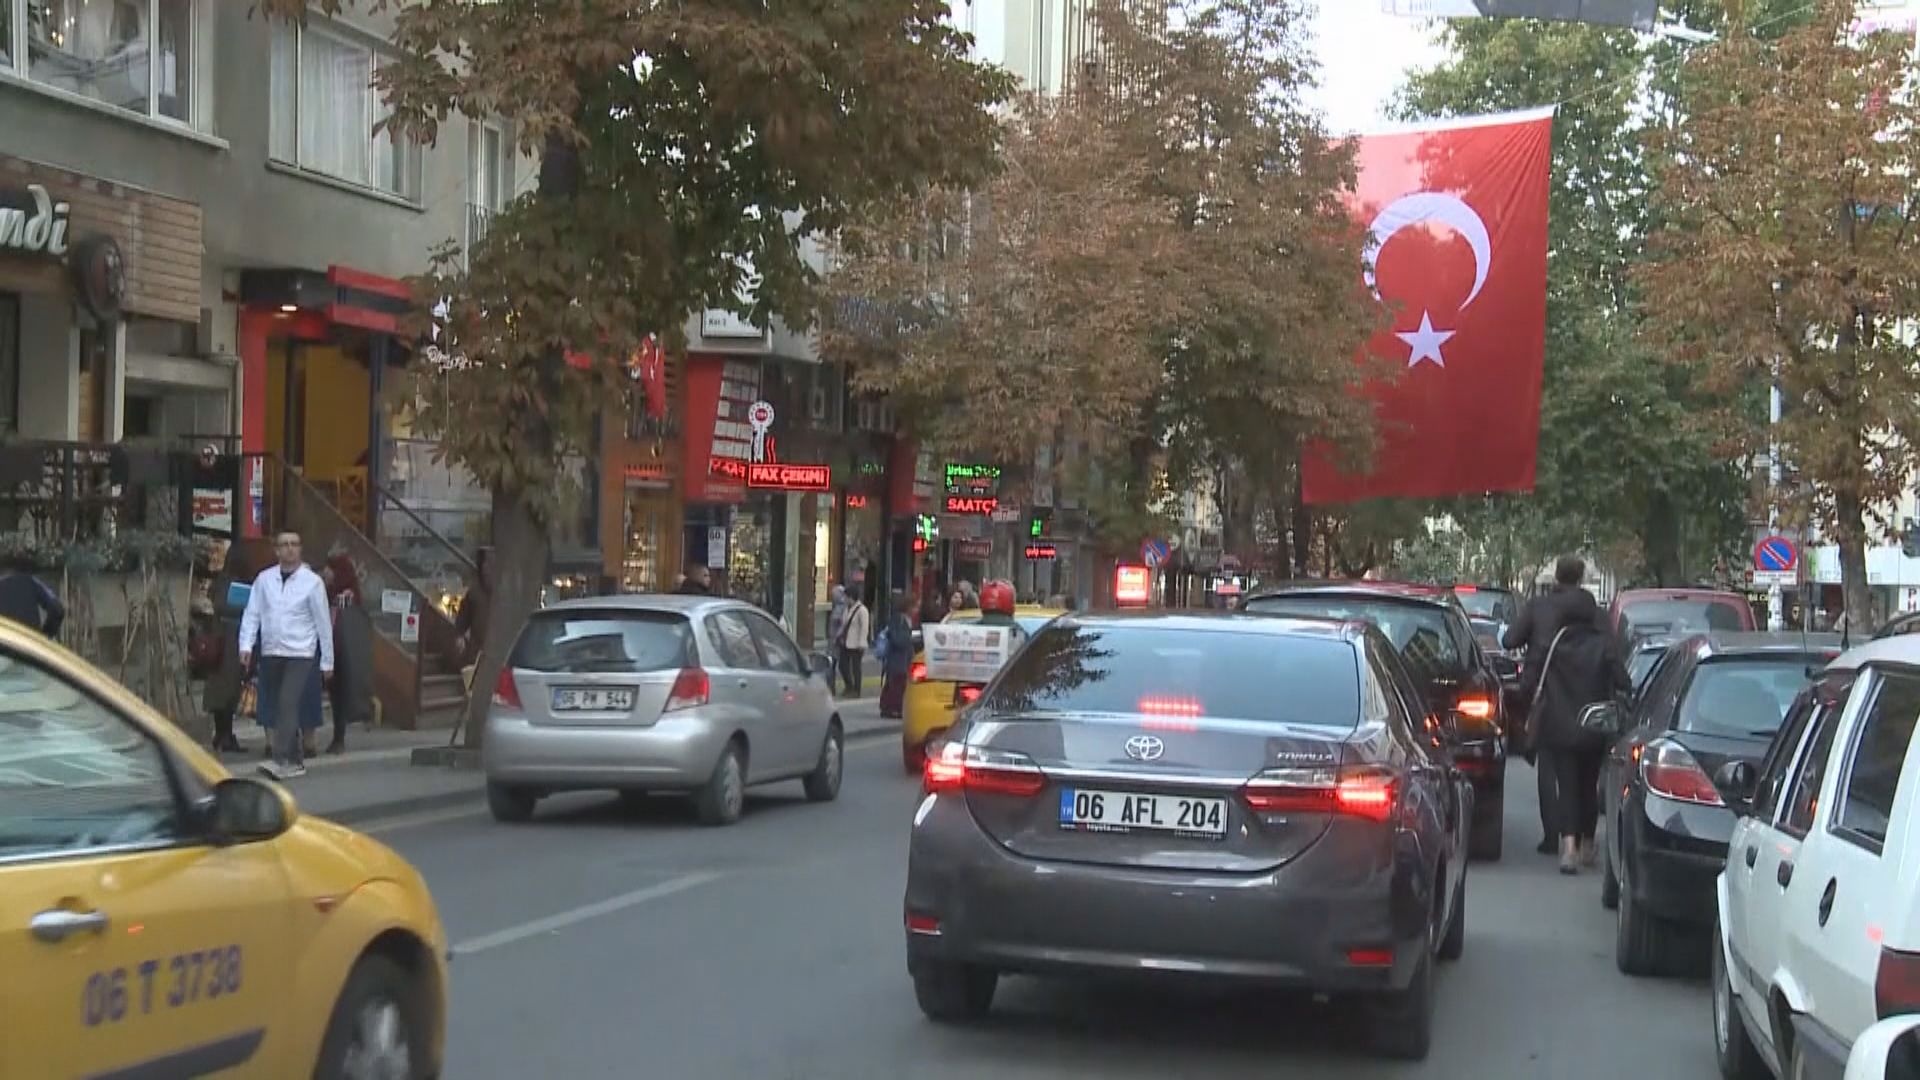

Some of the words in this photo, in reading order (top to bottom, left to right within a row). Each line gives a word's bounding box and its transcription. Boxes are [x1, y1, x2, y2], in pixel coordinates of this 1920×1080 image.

[752, 466, 779, 482] FAX
[1075, 793, 1104, 820] 06
[1120, 797, 1164, 825] AFL
[1176, 800, 1221, 829] 204
[83, 968, 127, 1027] 06
[138, 959, 160, 1015] T
